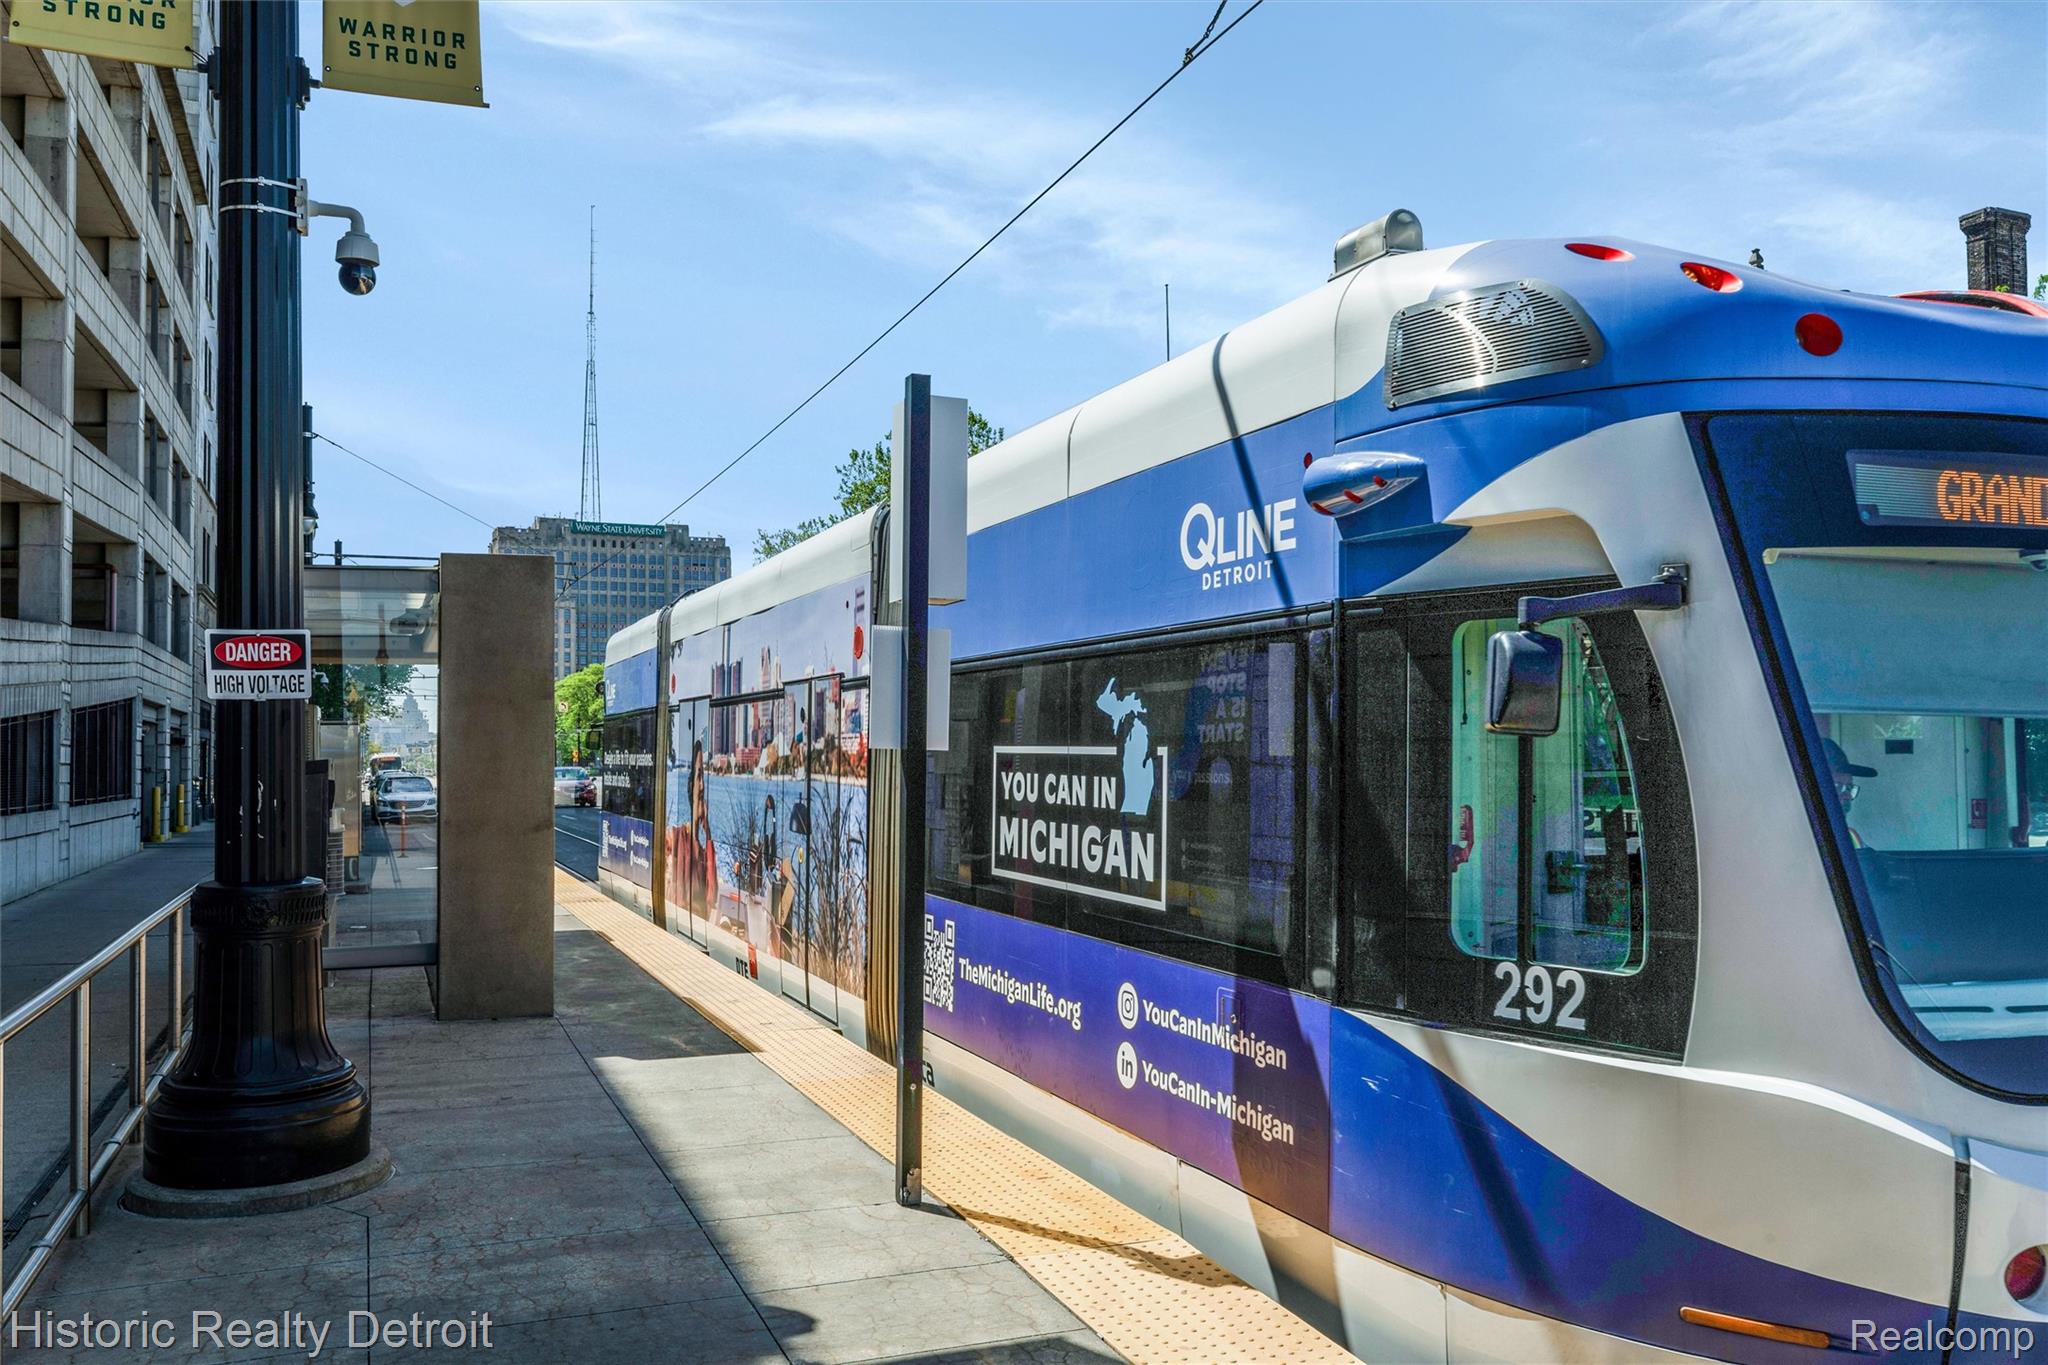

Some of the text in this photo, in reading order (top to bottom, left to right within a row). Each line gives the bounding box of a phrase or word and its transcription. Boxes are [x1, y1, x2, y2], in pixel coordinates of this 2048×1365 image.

[42, 0, 166, 30] STRONG
[338, 16, 466, 50] WARRIOR
[348, 40, 457, 70] STRONG
[1936, 469, 2048, 527] GRAND
[575, 521, 663, 536] WAYNE STATE UNIVERSITY
[1180, 497, 1297, 571] QLINE
[1201, 559, 1274, 591] DETROIT
[225, 642, 292, 662] DANGER
[213, 674, 305, 694] HIGH VOLTAGE
[1000, 771, 1117, 810] YOU CAN IN
[999, 815, 1155, 883] MICHIGAN
[958, 957, 1082, 1031] TheMichiganLife.org
[1493, 961, 1586, 1031] 292
[1142, 1000, 1287, 1070] YouCanInMichigan
[1142, 1060, 1294, 1146] YouCanIn-Michigan
